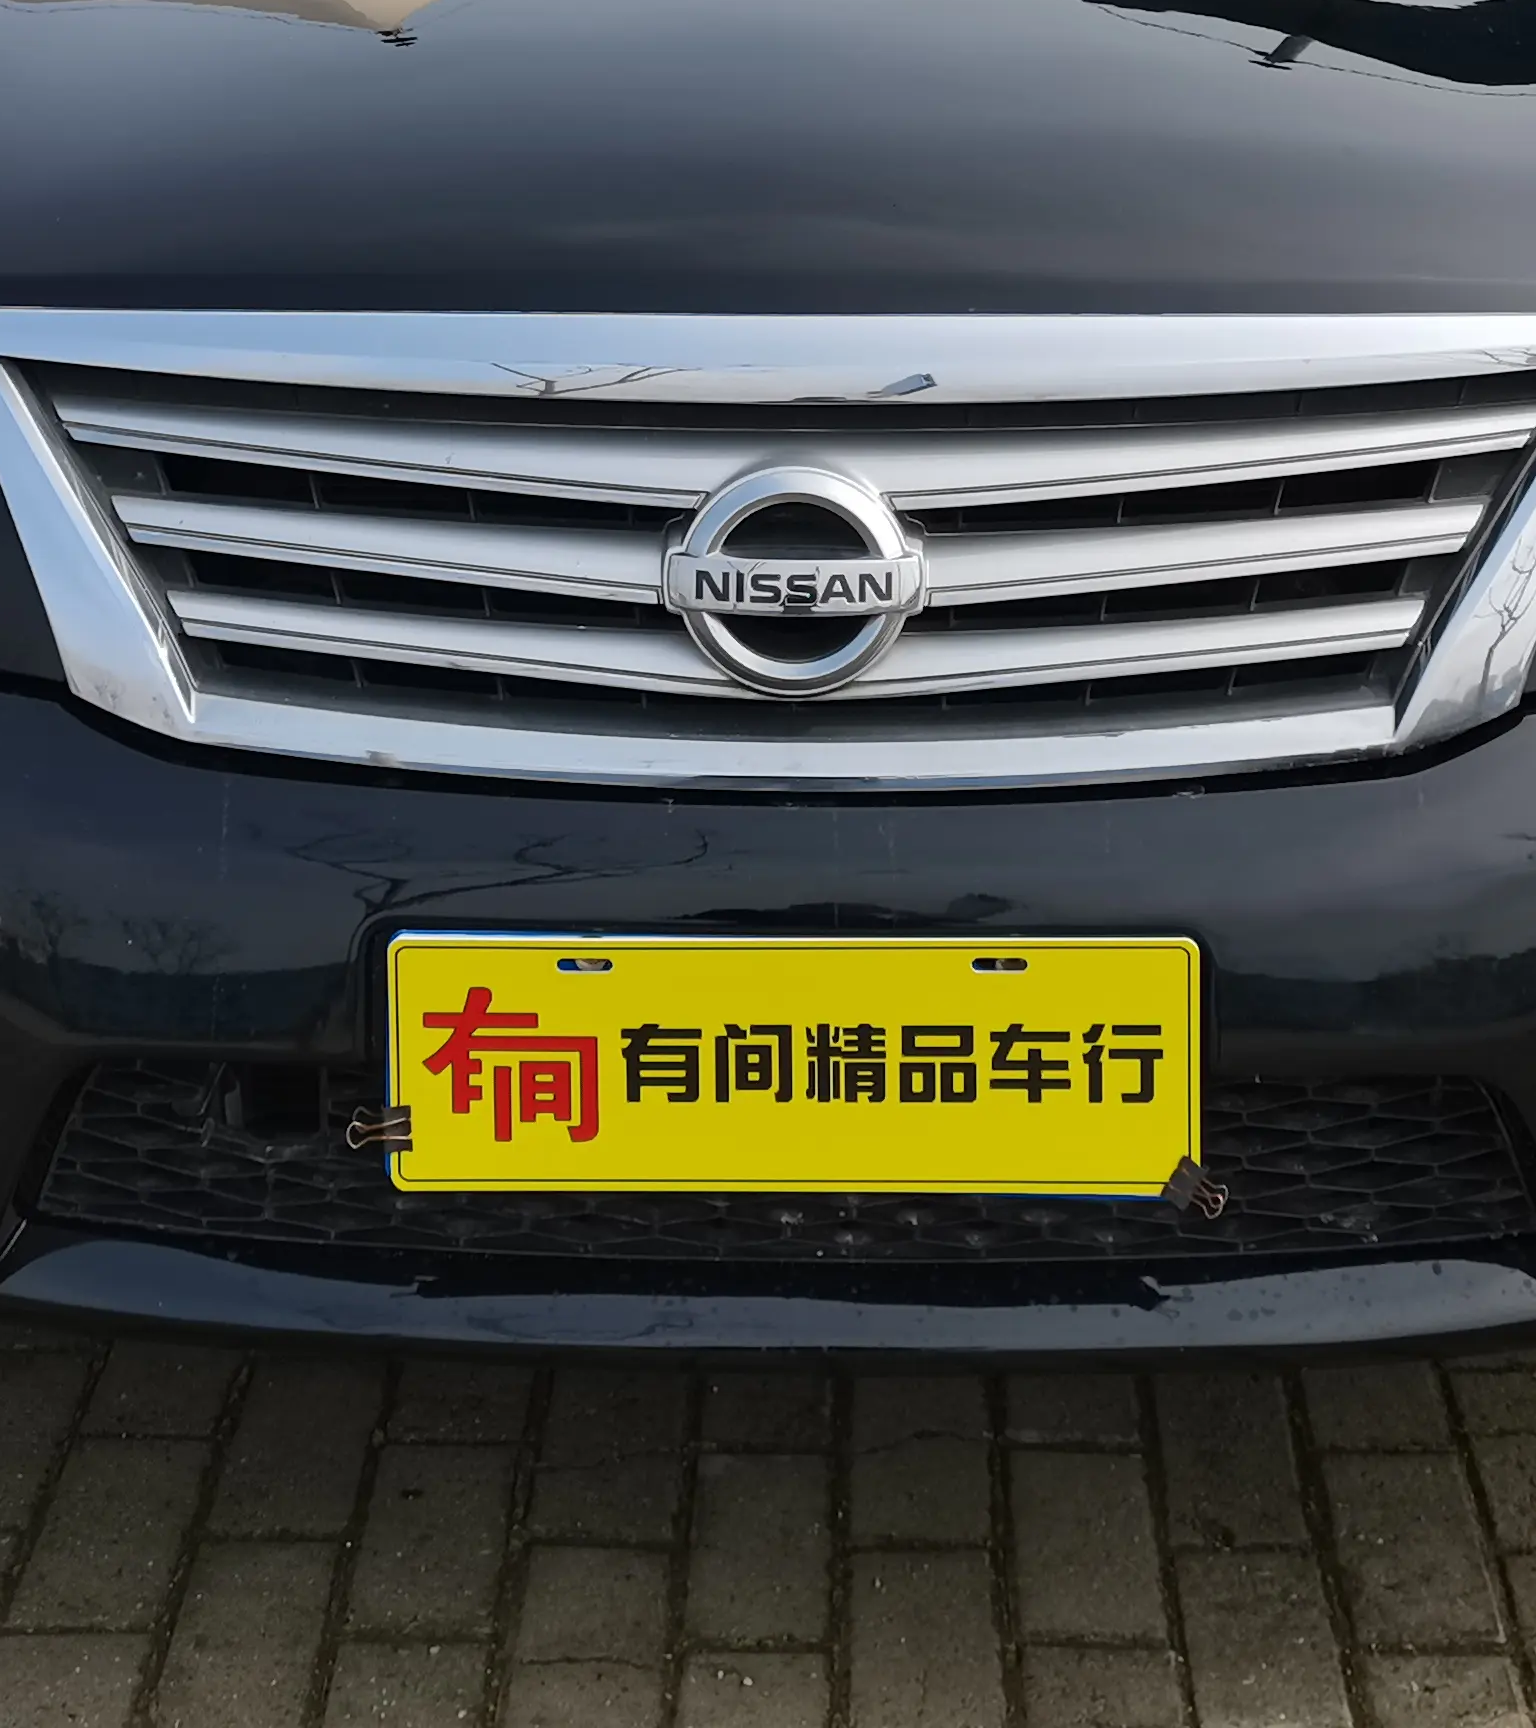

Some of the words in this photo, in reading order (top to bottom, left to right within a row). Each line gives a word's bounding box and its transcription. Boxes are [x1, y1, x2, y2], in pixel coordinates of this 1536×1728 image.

[695, 569, 892, 603] NISSAN
[620, 1023, 1164, 1105] 有间精品车行
